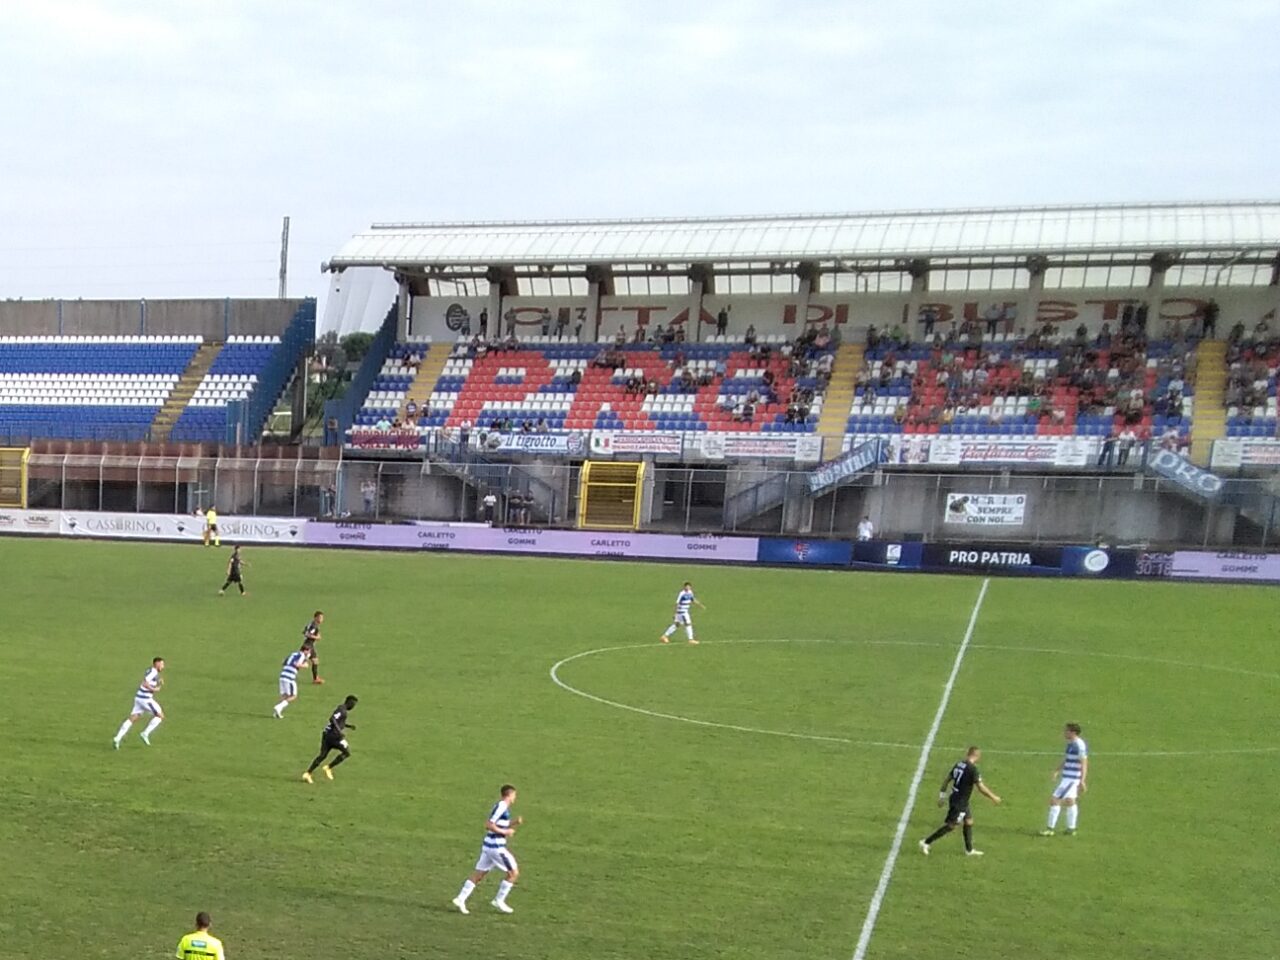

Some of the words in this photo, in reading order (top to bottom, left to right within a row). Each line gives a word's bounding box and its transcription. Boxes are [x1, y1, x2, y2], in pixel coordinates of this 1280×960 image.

[1150, 450, 1222, 491] PRO
[977, 506, 1013, 514] SEMPRE
[417, 531, 456, 539] CARLETTO
[508, 538, 537, 546] GOMME
[590, 539, 631, 548] CARLETTO
[686, 543, 718, 551] GOMME
[949, 550, 978, 563] PRO
[981, 551, 1031, 565] PATRIA
